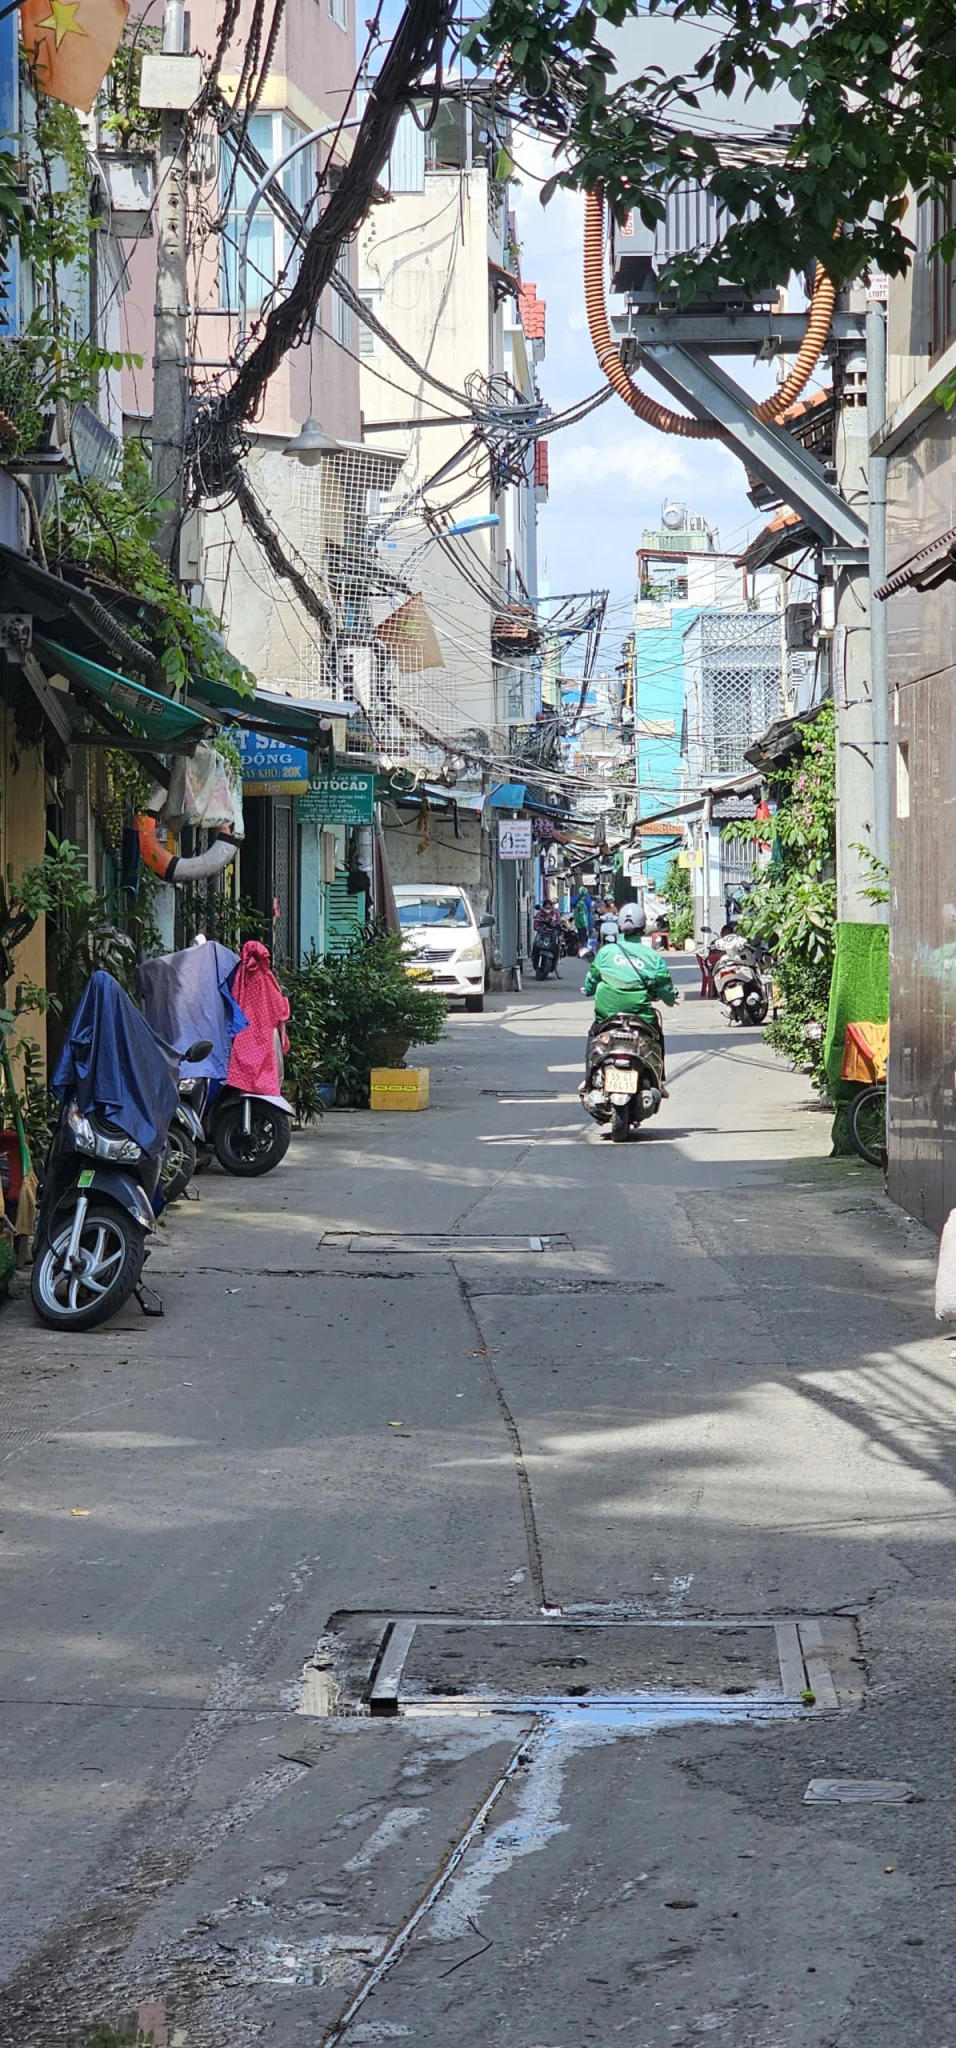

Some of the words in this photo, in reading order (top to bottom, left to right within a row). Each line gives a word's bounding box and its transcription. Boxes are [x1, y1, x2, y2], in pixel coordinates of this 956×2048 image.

[241, 752, 292, 766] ĐỘNG
[282, 766, 302, 778] 20K
[307, 781, 368, 791] AUTOCAD
[613, 954, 645, 970] Grab
